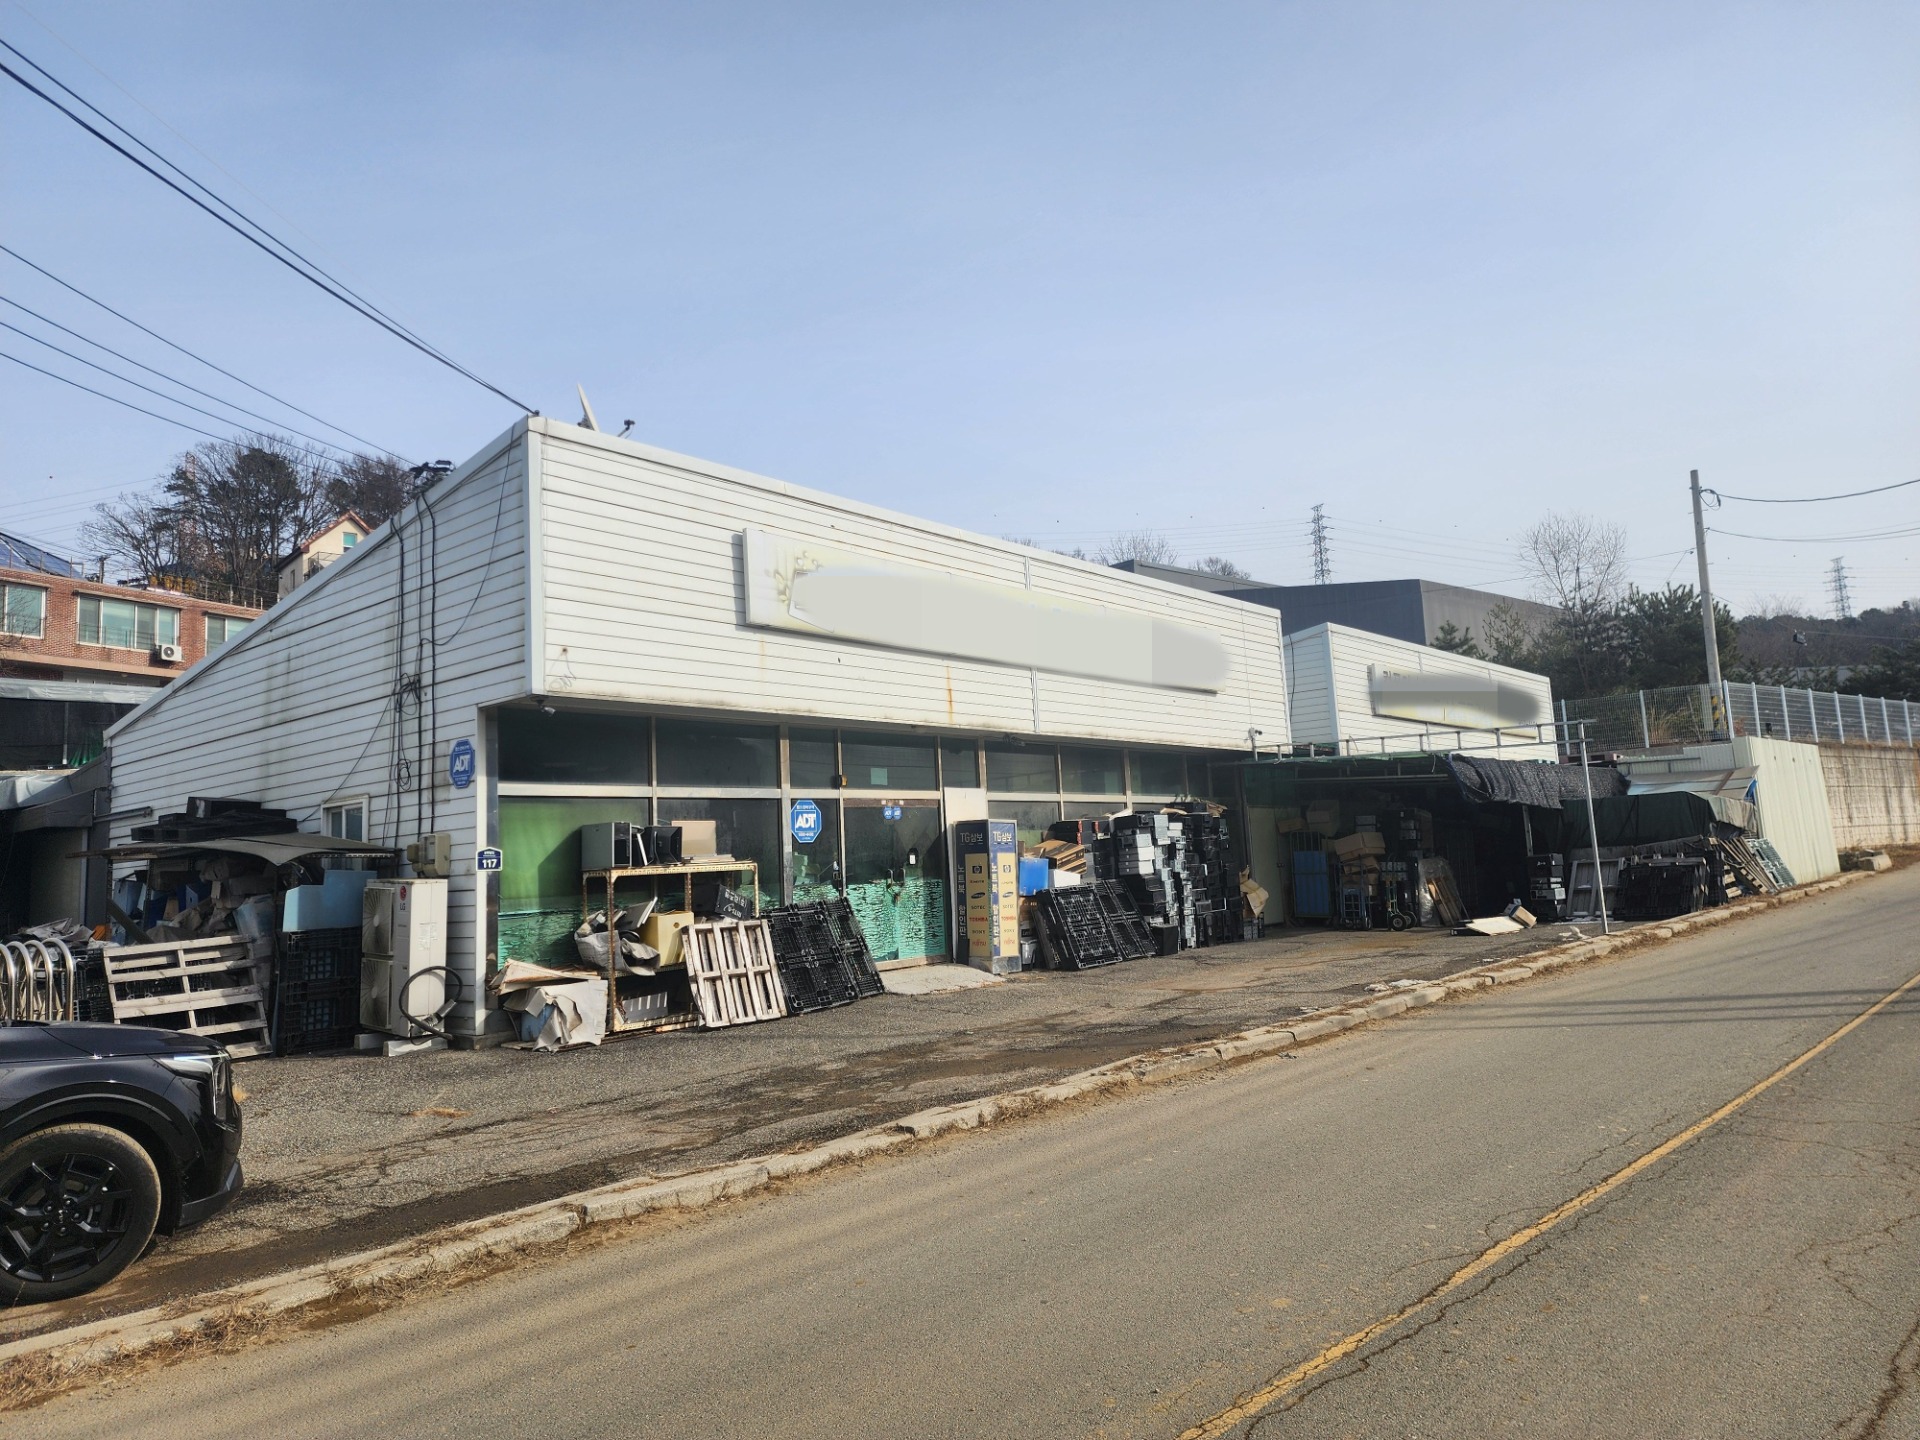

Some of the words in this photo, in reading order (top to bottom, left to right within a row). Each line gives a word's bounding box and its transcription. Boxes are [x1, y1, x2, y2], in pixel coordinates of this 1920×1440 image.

[453, 754, 471, 773] ADT
[795, 813, 817, 829] ADT
[960, 831, 984, 843] TG삼보
[992, 830, 1013, 842] TG삼보
[482, 859, 498, 869] 117
[958, 864, 966, 895] 노트북
[399, 902, 406, 911] LG
